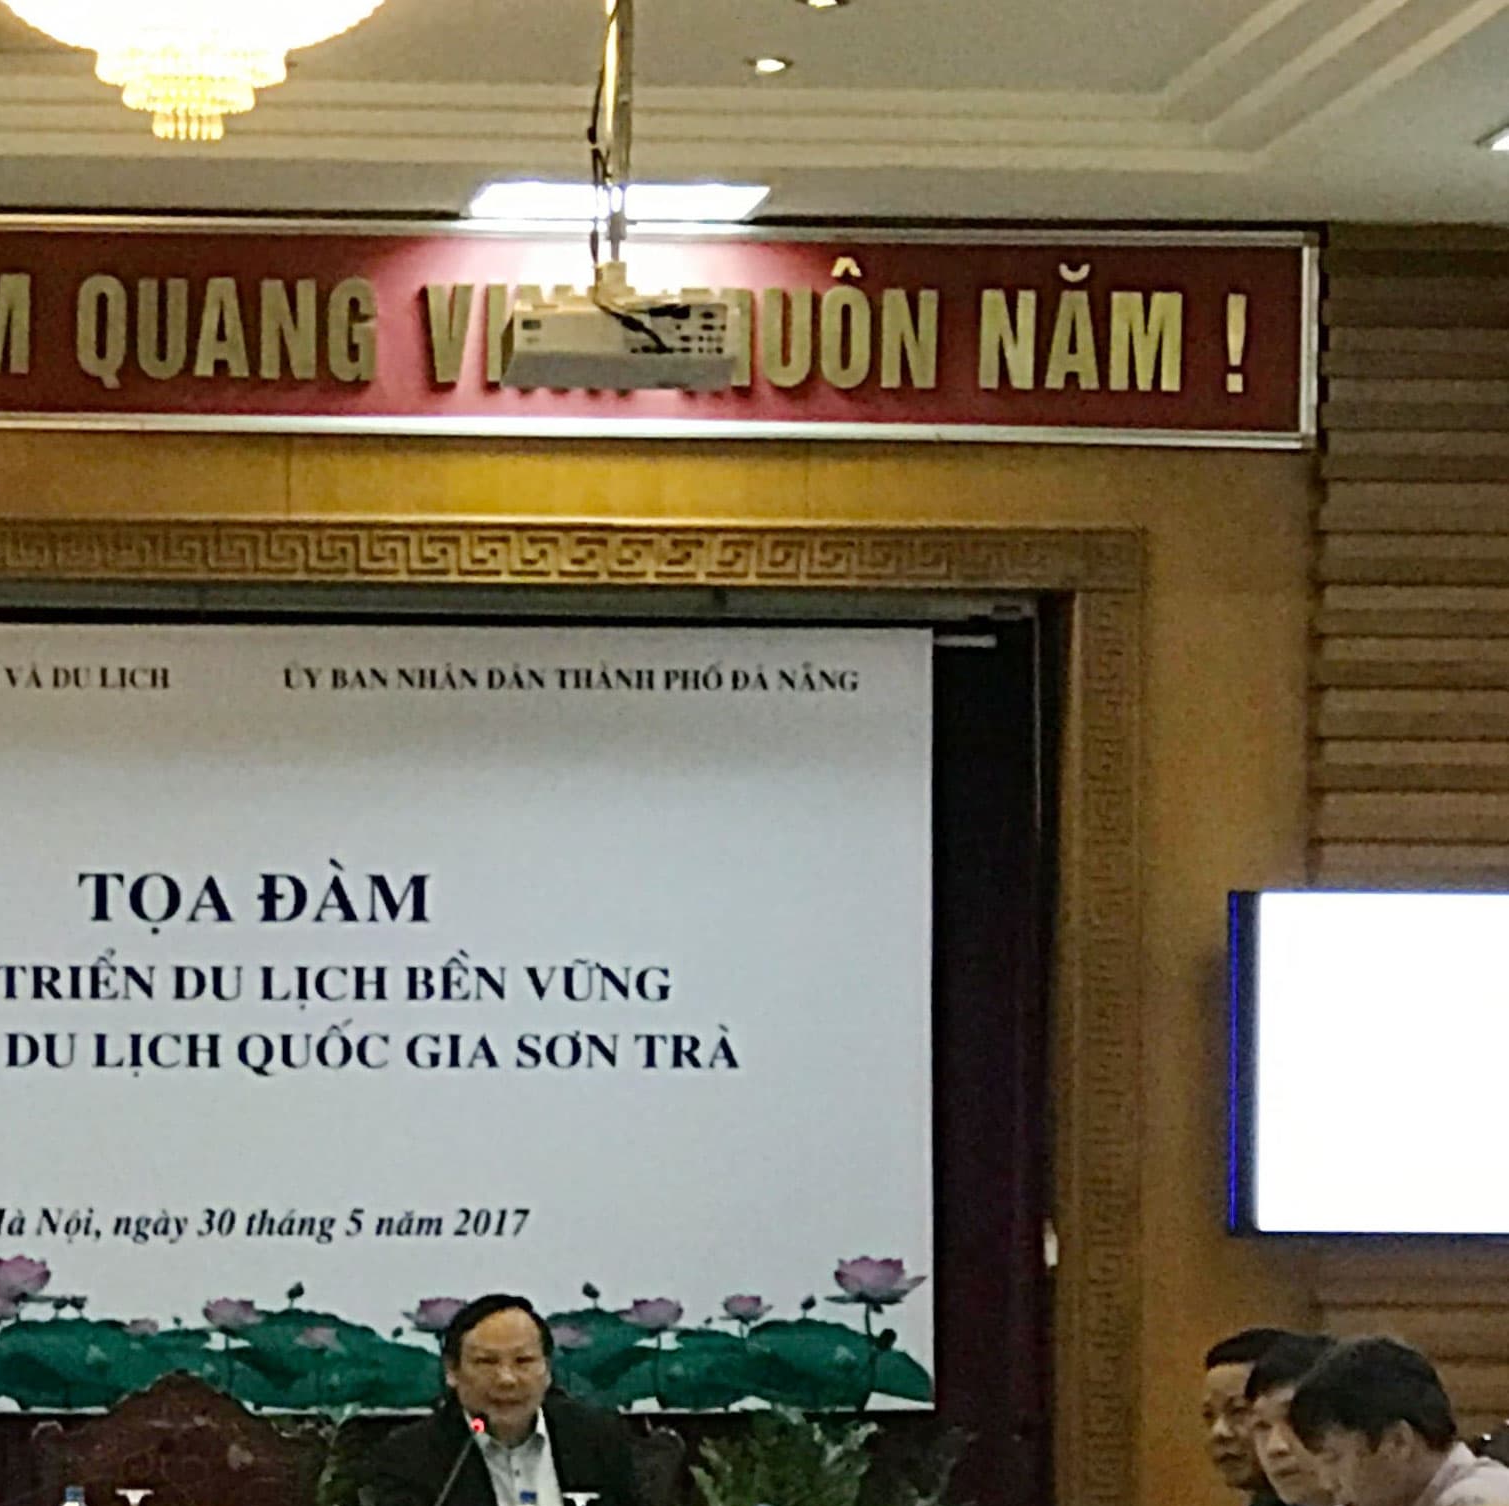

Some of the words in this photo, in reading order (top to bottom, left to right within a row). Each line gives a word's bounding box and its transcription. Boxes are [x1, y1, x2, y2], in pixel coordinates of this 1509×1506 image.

[76, 274, 378, 389] QUANG
[427, 284, 636, 390] VI
[978, 262, 1183, 392] NĂM
[1226, 292, 1248, 394] !
[52, 666, 91, 689] DU
[331, 666, 389, 689] BAN
[77, 872, 235, 935] TỌA
[256, 857, 431, 923] ĐÀM
[172, 965, 244, 1001] DU
[259, 965, 389, 1010] LỊCH
[405, 948, 508, 1002] BỀN
[523, 957, 672, 1002] VỮNG
[5, 1033, 77, 1069] DU
[91, 1033, 222, 1078] LỊCH
[237, 1017, 391, 1078] QUỐC
[405, 1033, 501, 1070] GIA
[515, 1028, 620, 1070] SƠN
[633, 1023, 741, 1070] TRÀ
[34, 1207, 103, 1242] Nội,
[113, 1209, 189, 1245] ngày
[196, 1207, 237, 1238] 30
[245, 1207, 335, 1245] tháng
[344, 1207, 366, 1238] 5
[374, 1207, 444, 1238] năm
[453, 1207, 531, 1238] 2017
